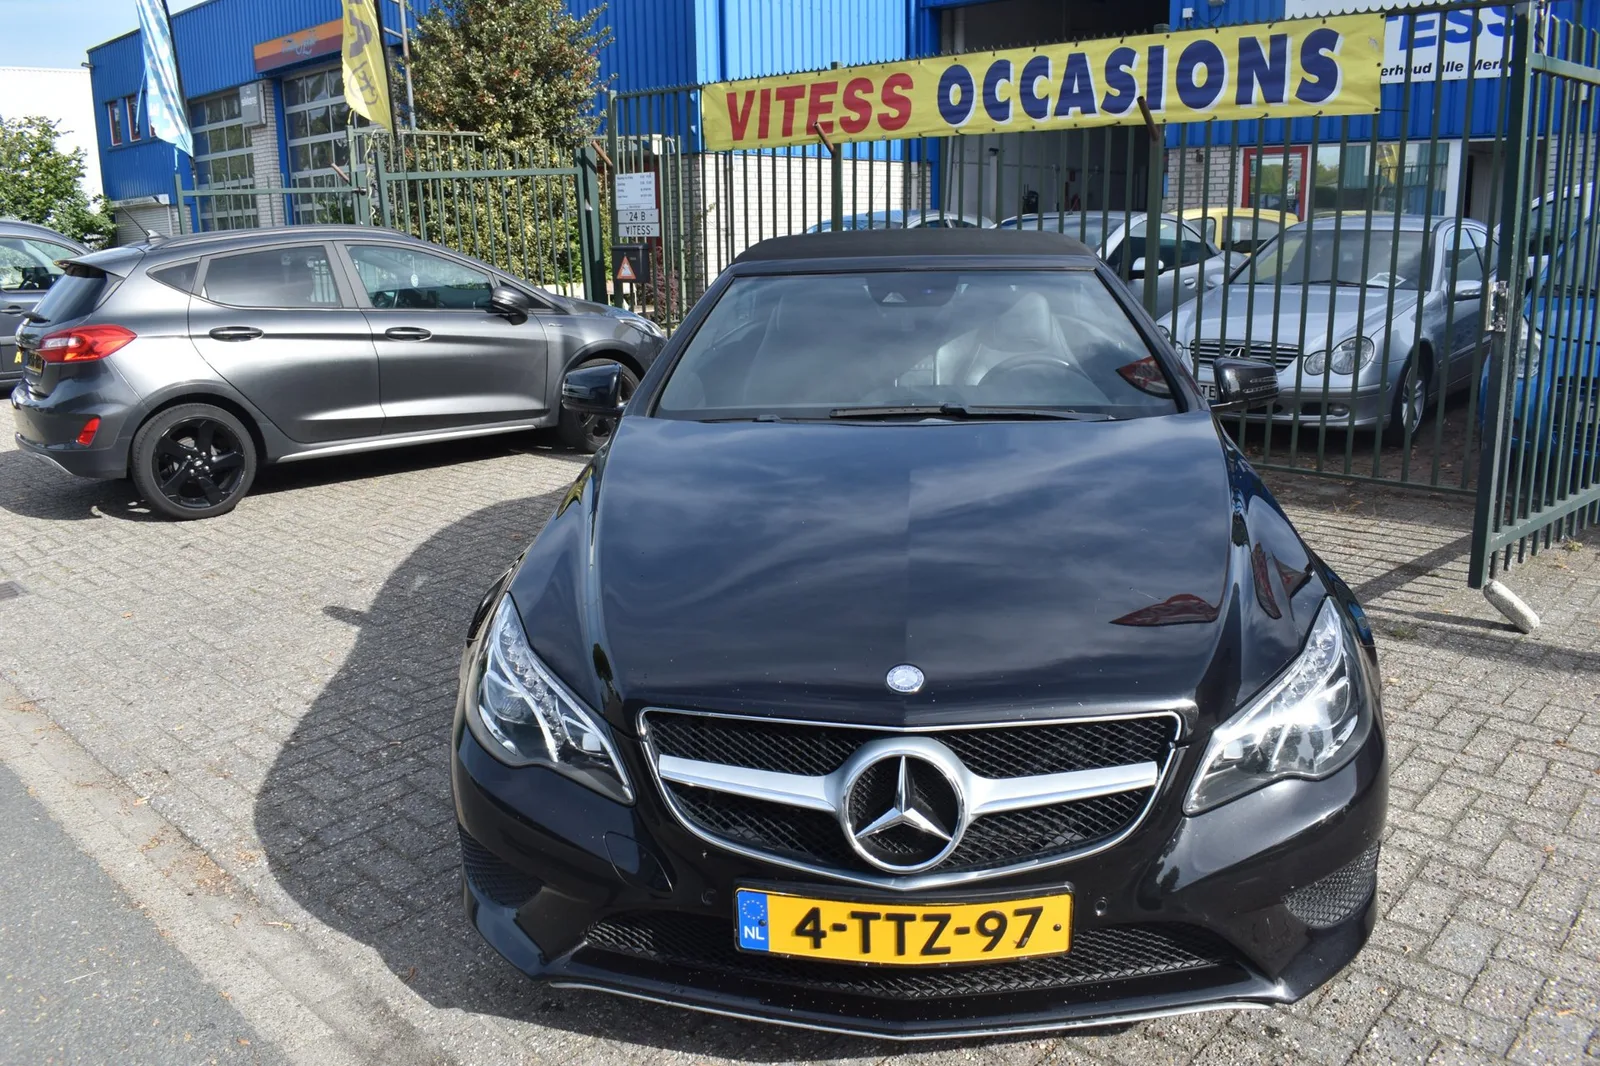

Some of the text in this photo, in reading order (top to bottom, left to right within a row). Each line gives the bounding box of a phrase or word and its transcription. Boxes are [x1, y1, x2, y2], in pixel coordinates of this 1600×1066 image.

[725, 27, 1342, 141] VITESS OCCASIONS
[625, 225, 651, 236] VITESS
[629, 211, 646, 221] 24 B
[743, 906, 1044, 957] NL 4-TTZ-97
